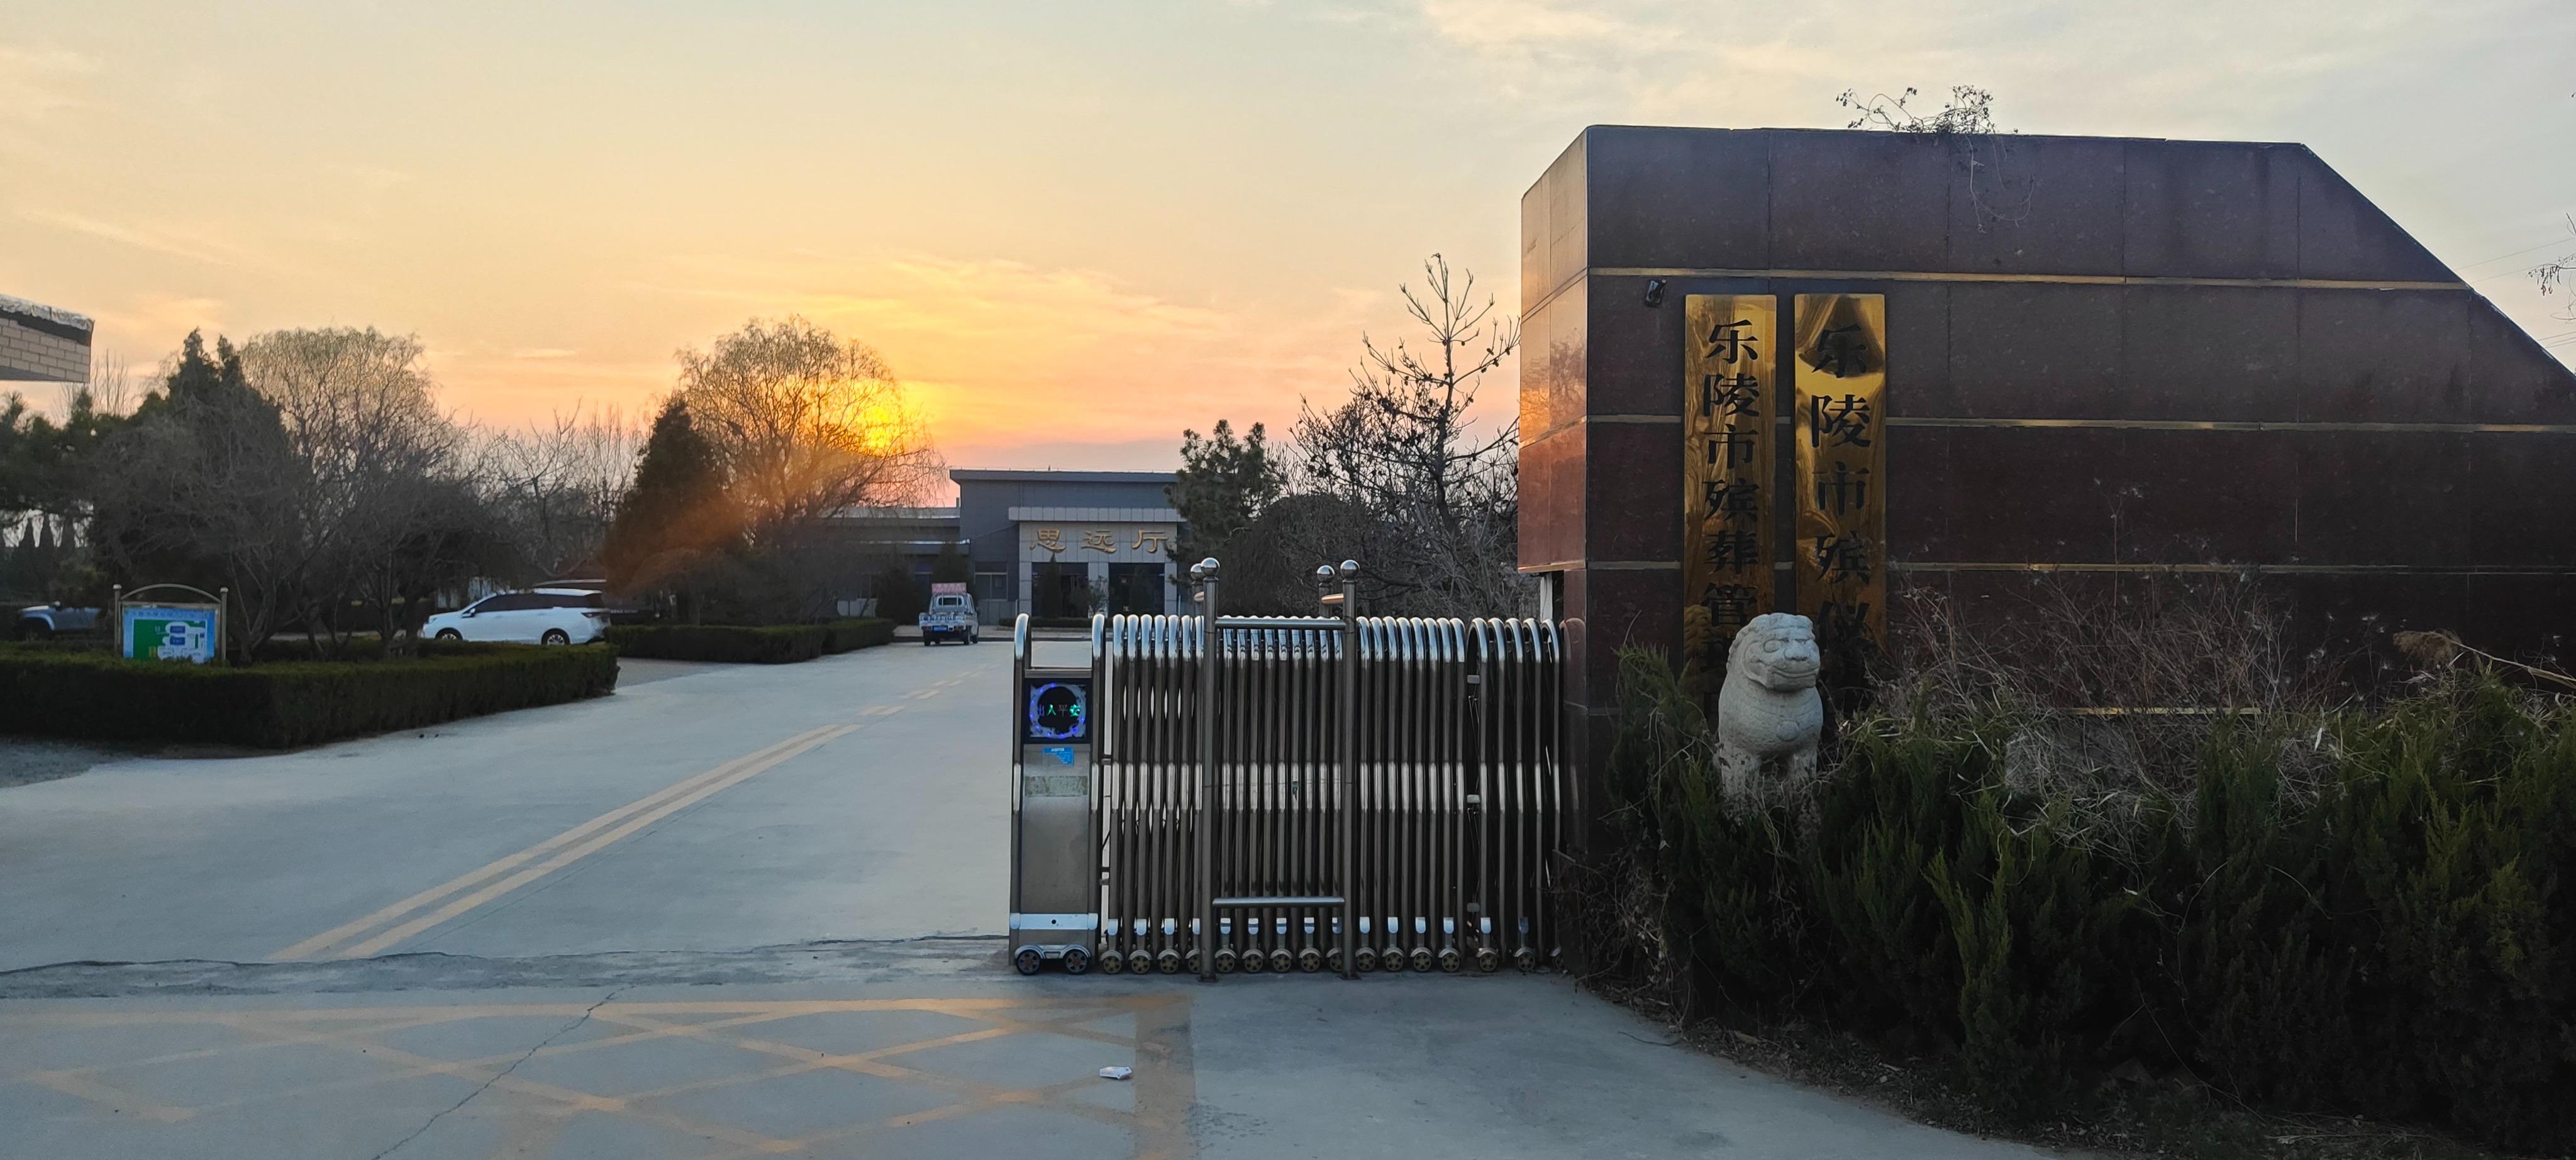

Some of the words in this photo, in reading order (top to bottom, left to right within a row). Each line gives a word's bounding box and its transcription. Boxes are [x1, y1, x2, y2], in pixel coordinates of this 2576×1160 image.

[1029, 528, 1169, 554] 思远厅
[1701, 318, 1760, 718] 乐陵市殡葬管
[1810, 323, 1872, 713] 乐陵市殡仪
